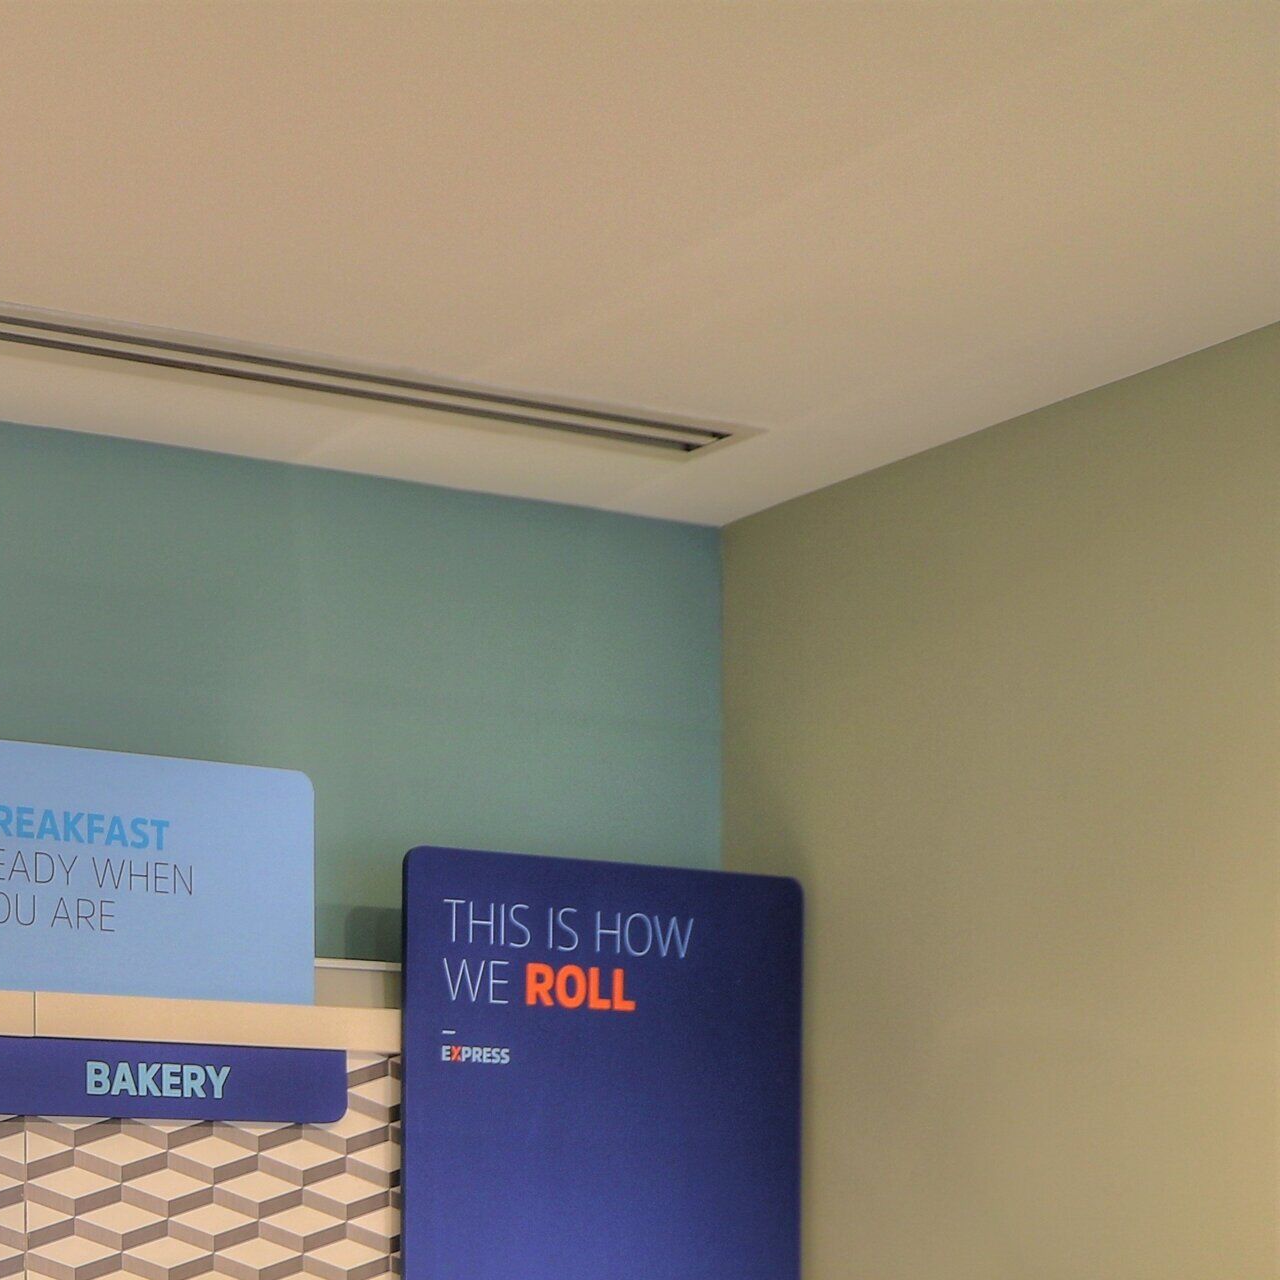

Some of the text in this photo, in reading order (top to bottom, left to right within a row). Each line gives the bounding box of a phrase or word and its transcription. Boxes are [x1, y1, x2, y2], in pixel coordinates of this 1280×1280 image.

[91, 856, 194, 896] WHEN
[50, 896, 116, 933] ARE
[443, 898, 694, 958] THIS IS HOW
[443, 957, 636, 1012] WE ROLL
[441, 1045, 510, 1064] EXPRESS
[86, 1061, 231, 1099] BAKERY
